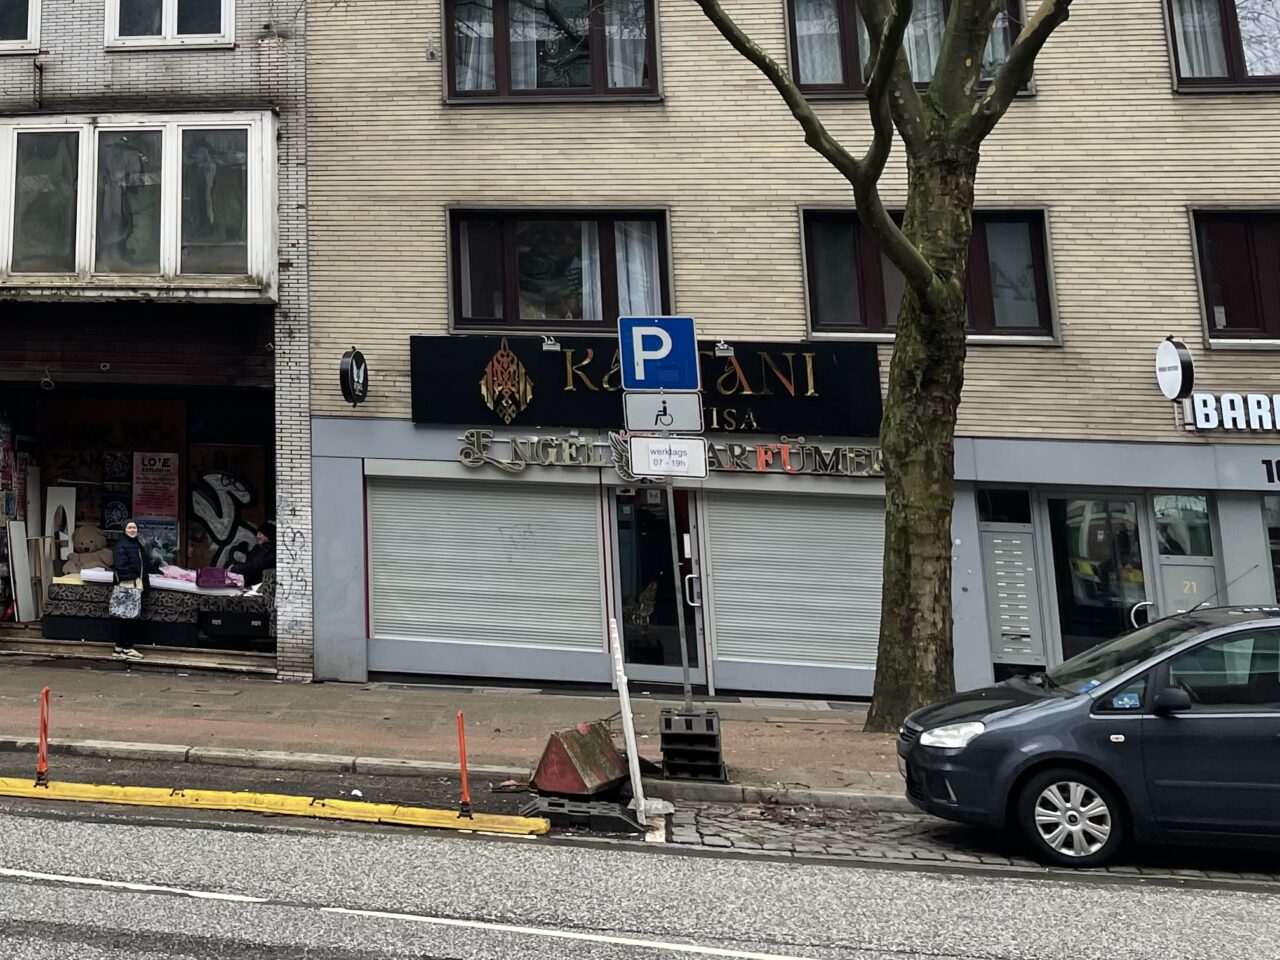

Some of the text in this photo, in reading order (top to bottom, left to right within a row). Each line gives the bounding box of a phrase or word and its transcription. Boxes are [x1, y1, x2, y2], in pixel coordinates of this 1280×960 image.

[631, 326, 672, 381] P
[1193, 393, 1280, 430] BAR
[650, 447, 688, 458] werktags
[672, 459, 686, 467] 19h
[702, 435, 885, 477] ARFÜME
[1183, 581, 1197, 594] 21
